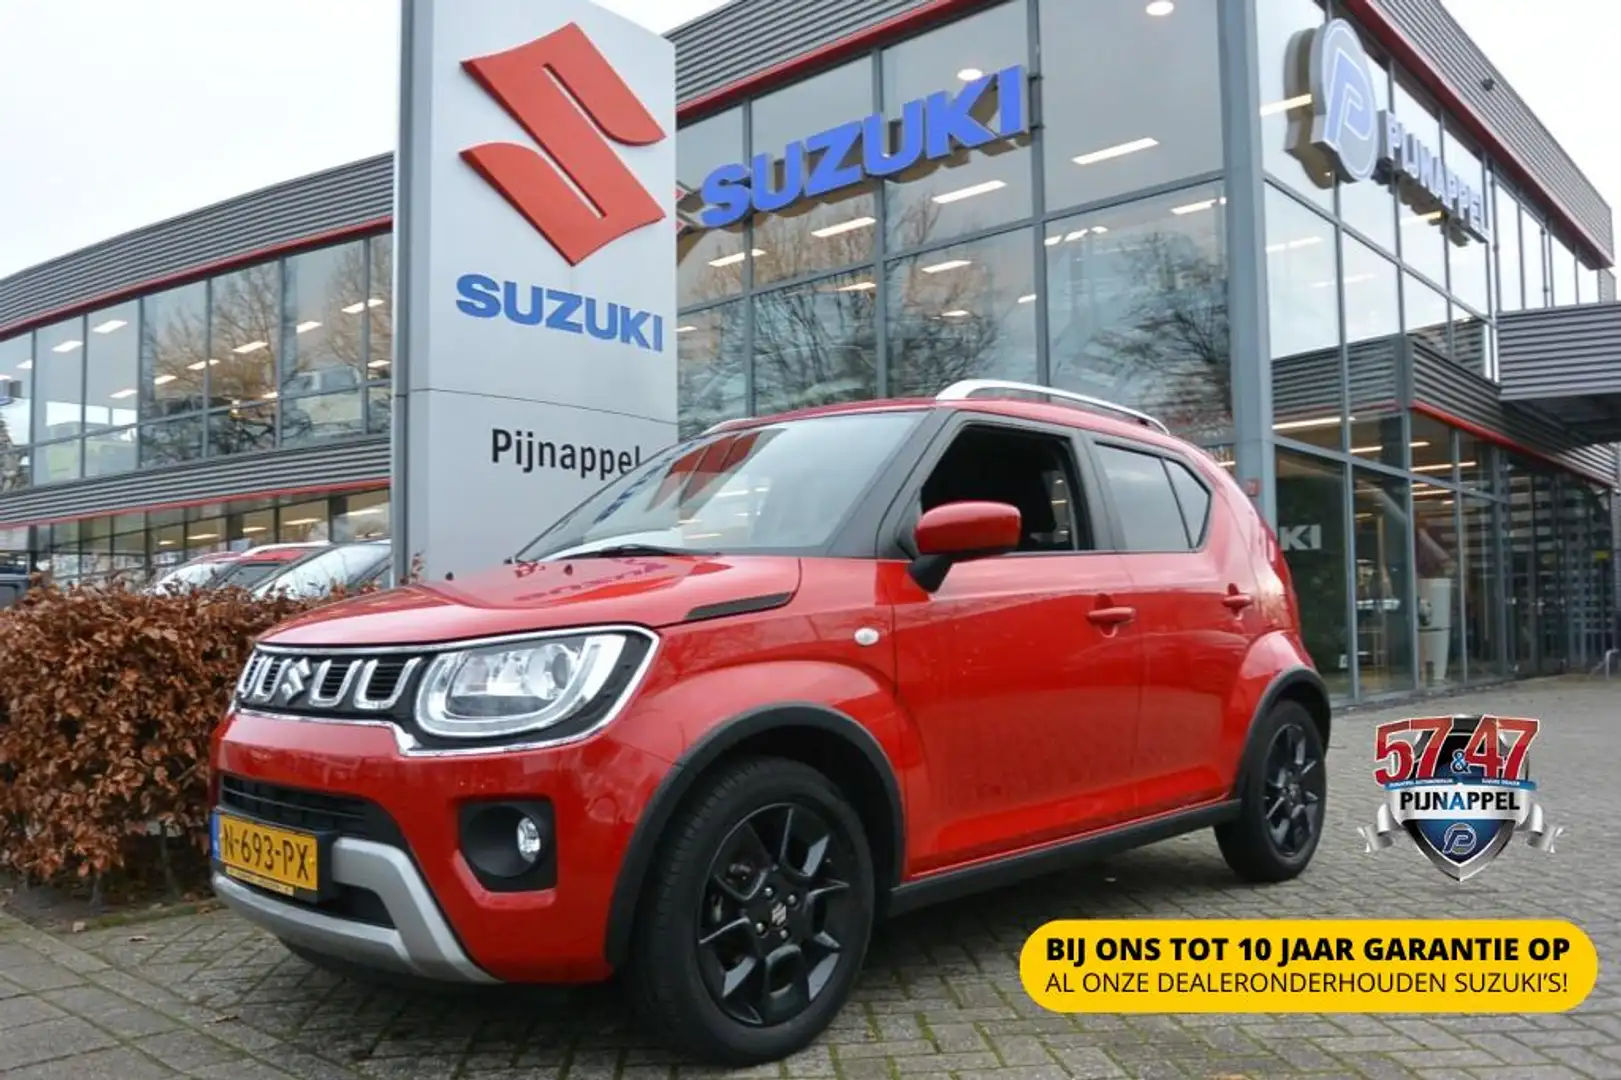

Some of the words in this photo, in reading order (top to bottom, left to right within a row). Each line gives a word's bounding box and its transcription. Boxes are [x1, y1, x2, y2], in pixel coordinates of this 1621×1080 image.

[700, 64, 1028, 229] SUZUKI
[1386, 111, 1489, 240] PIJNAPPEL
[455, 273, 664, 352] SUZUKI
[491, 428, 641, 480] Pijnappel
[222, 823, 309, 881] N-693-PX
